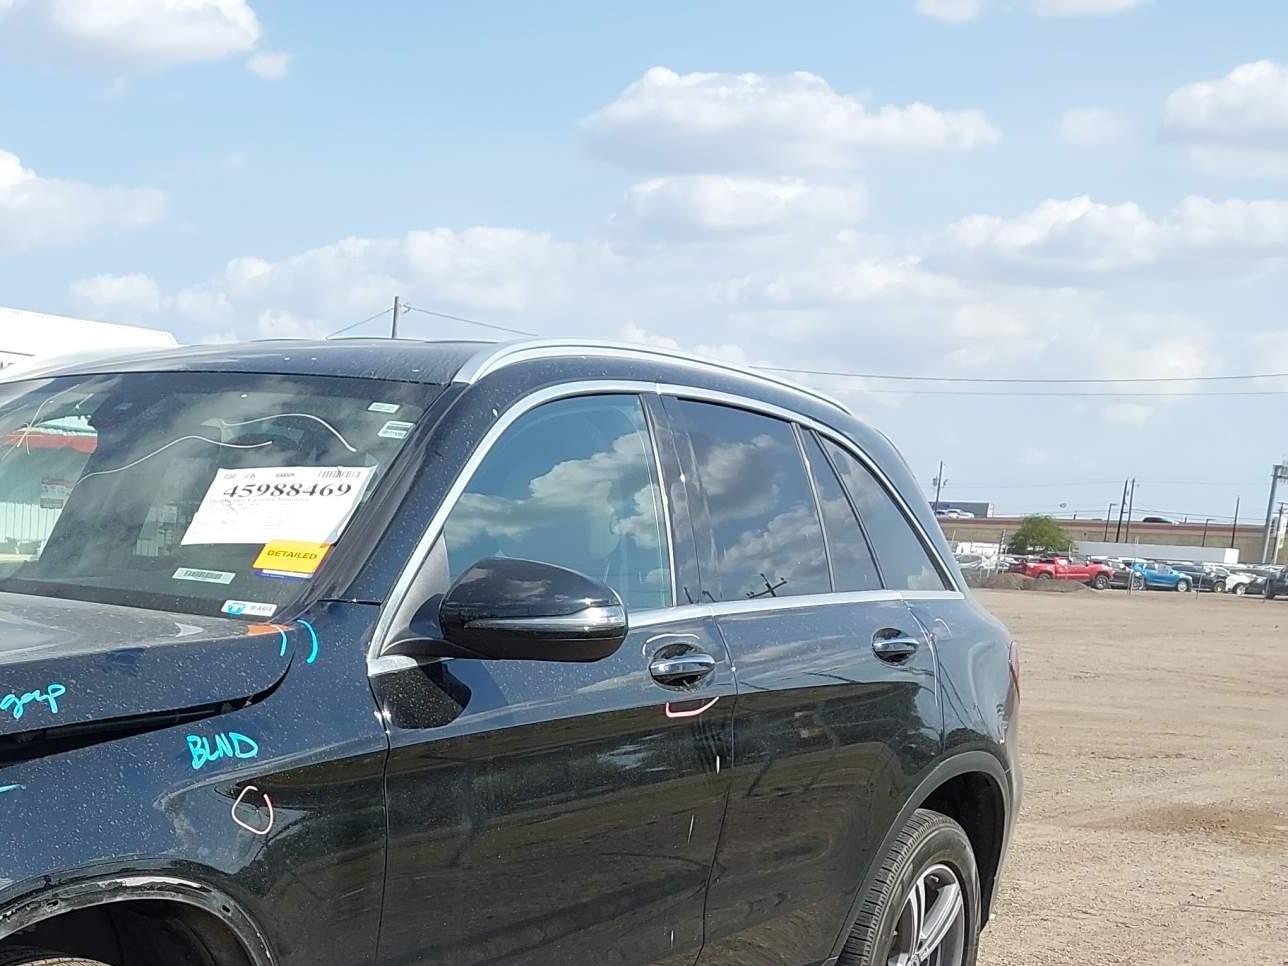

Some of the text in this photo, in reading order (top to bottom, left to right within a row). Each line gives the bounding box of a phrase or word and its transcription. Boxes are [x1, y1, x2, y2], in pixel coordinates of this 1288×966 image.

[223, 483, 352, 498] 45988469
[266, 549, 318, 561] DETAILED
[186, 732, 259, 770] BLND
